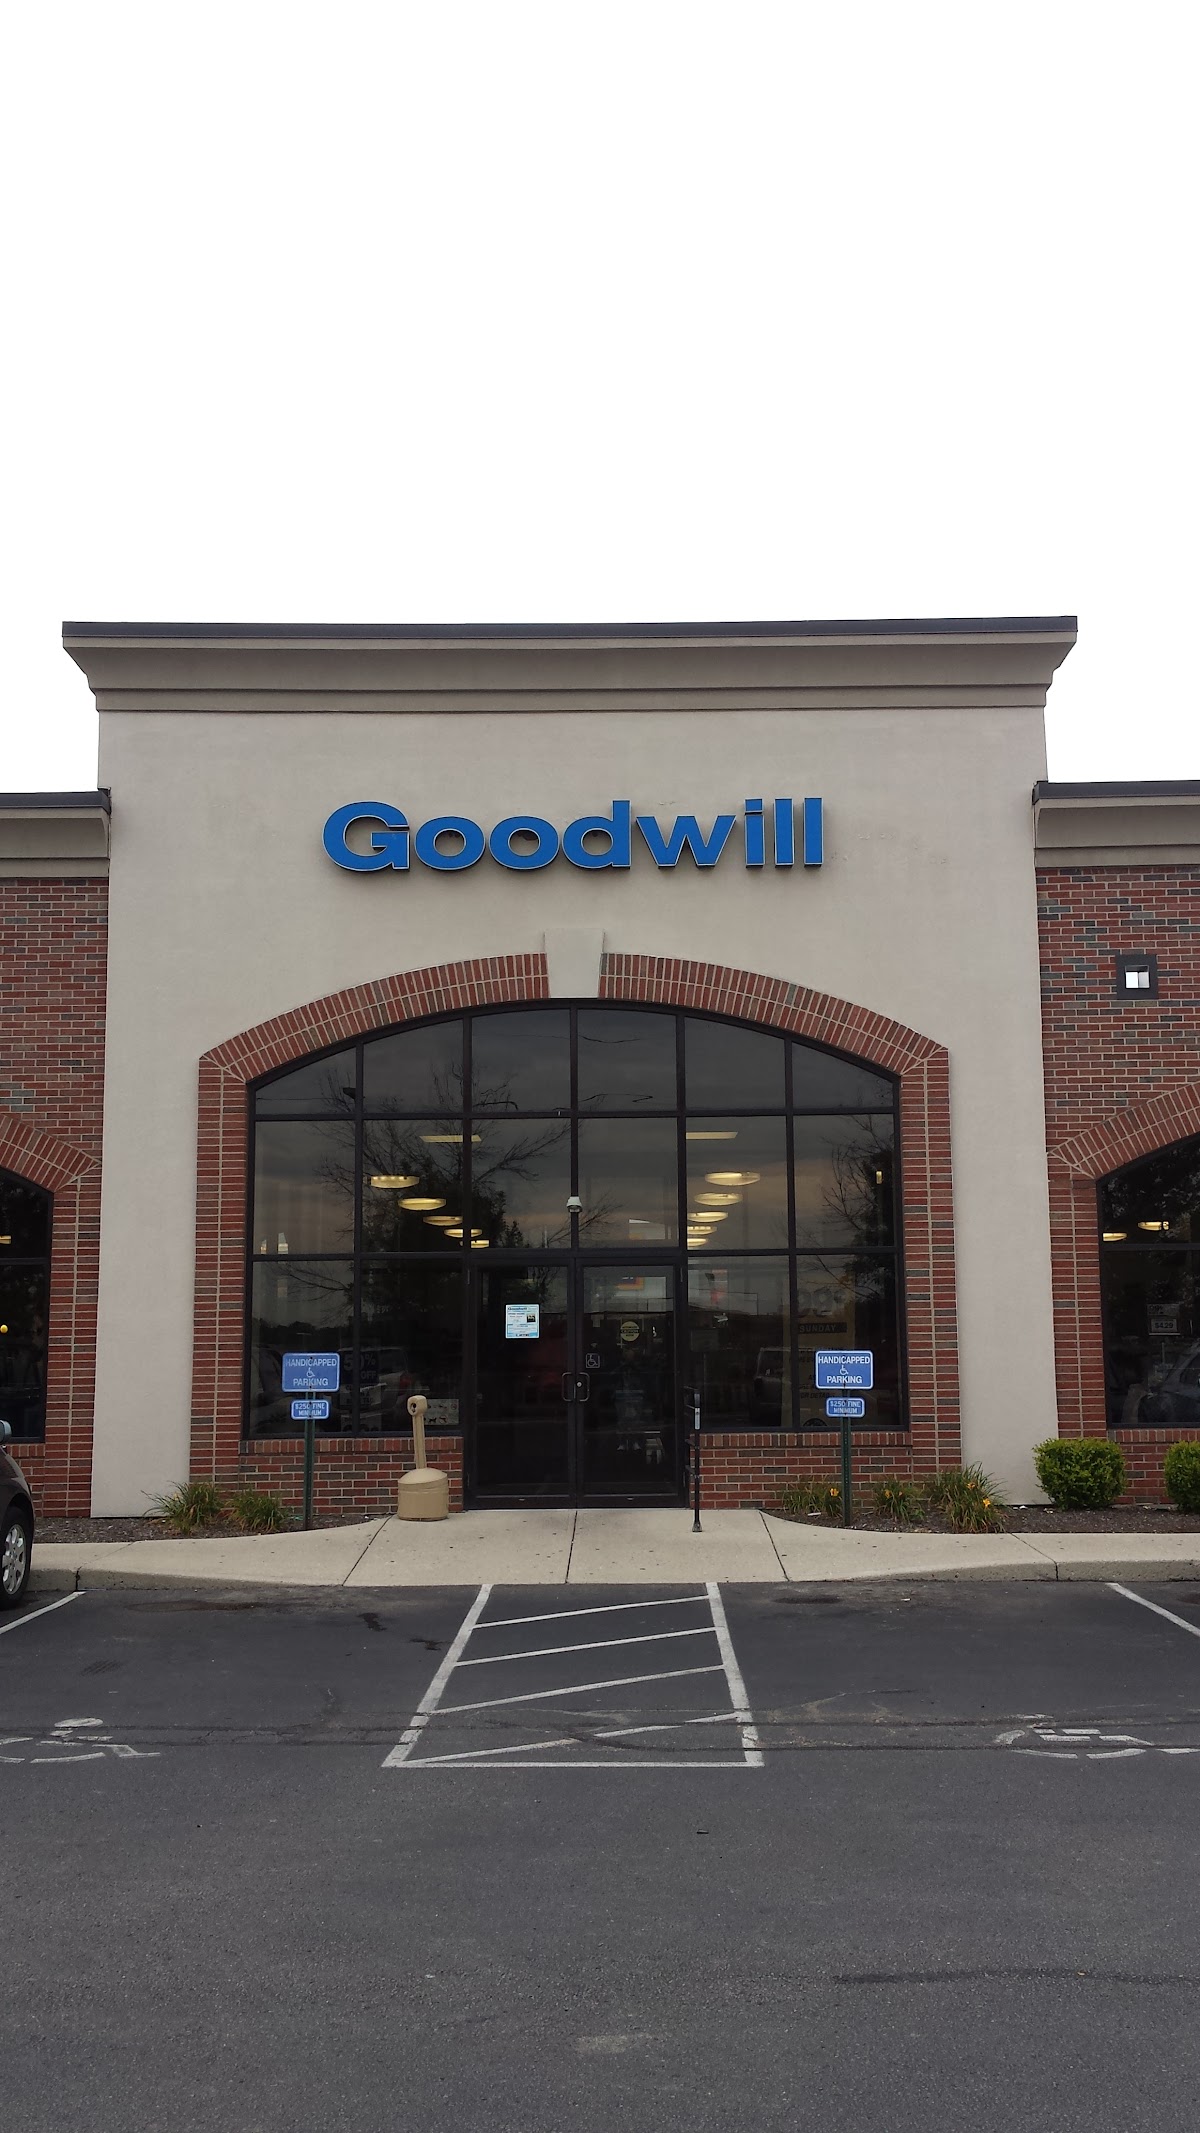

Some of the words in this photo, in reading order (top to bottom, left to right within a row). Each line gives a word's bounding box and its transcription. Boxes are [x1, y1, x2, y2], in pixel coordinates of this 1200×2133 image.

[322, 797, 824, 872] Goodwill
[799, 1324, 836, 1333] SUNDAY
[818, 1356, 870, 1364] HANDICAPPED
[293, 1378, 328, 1386] PARKING
[826, 1375, 863, 1384] PARKING
